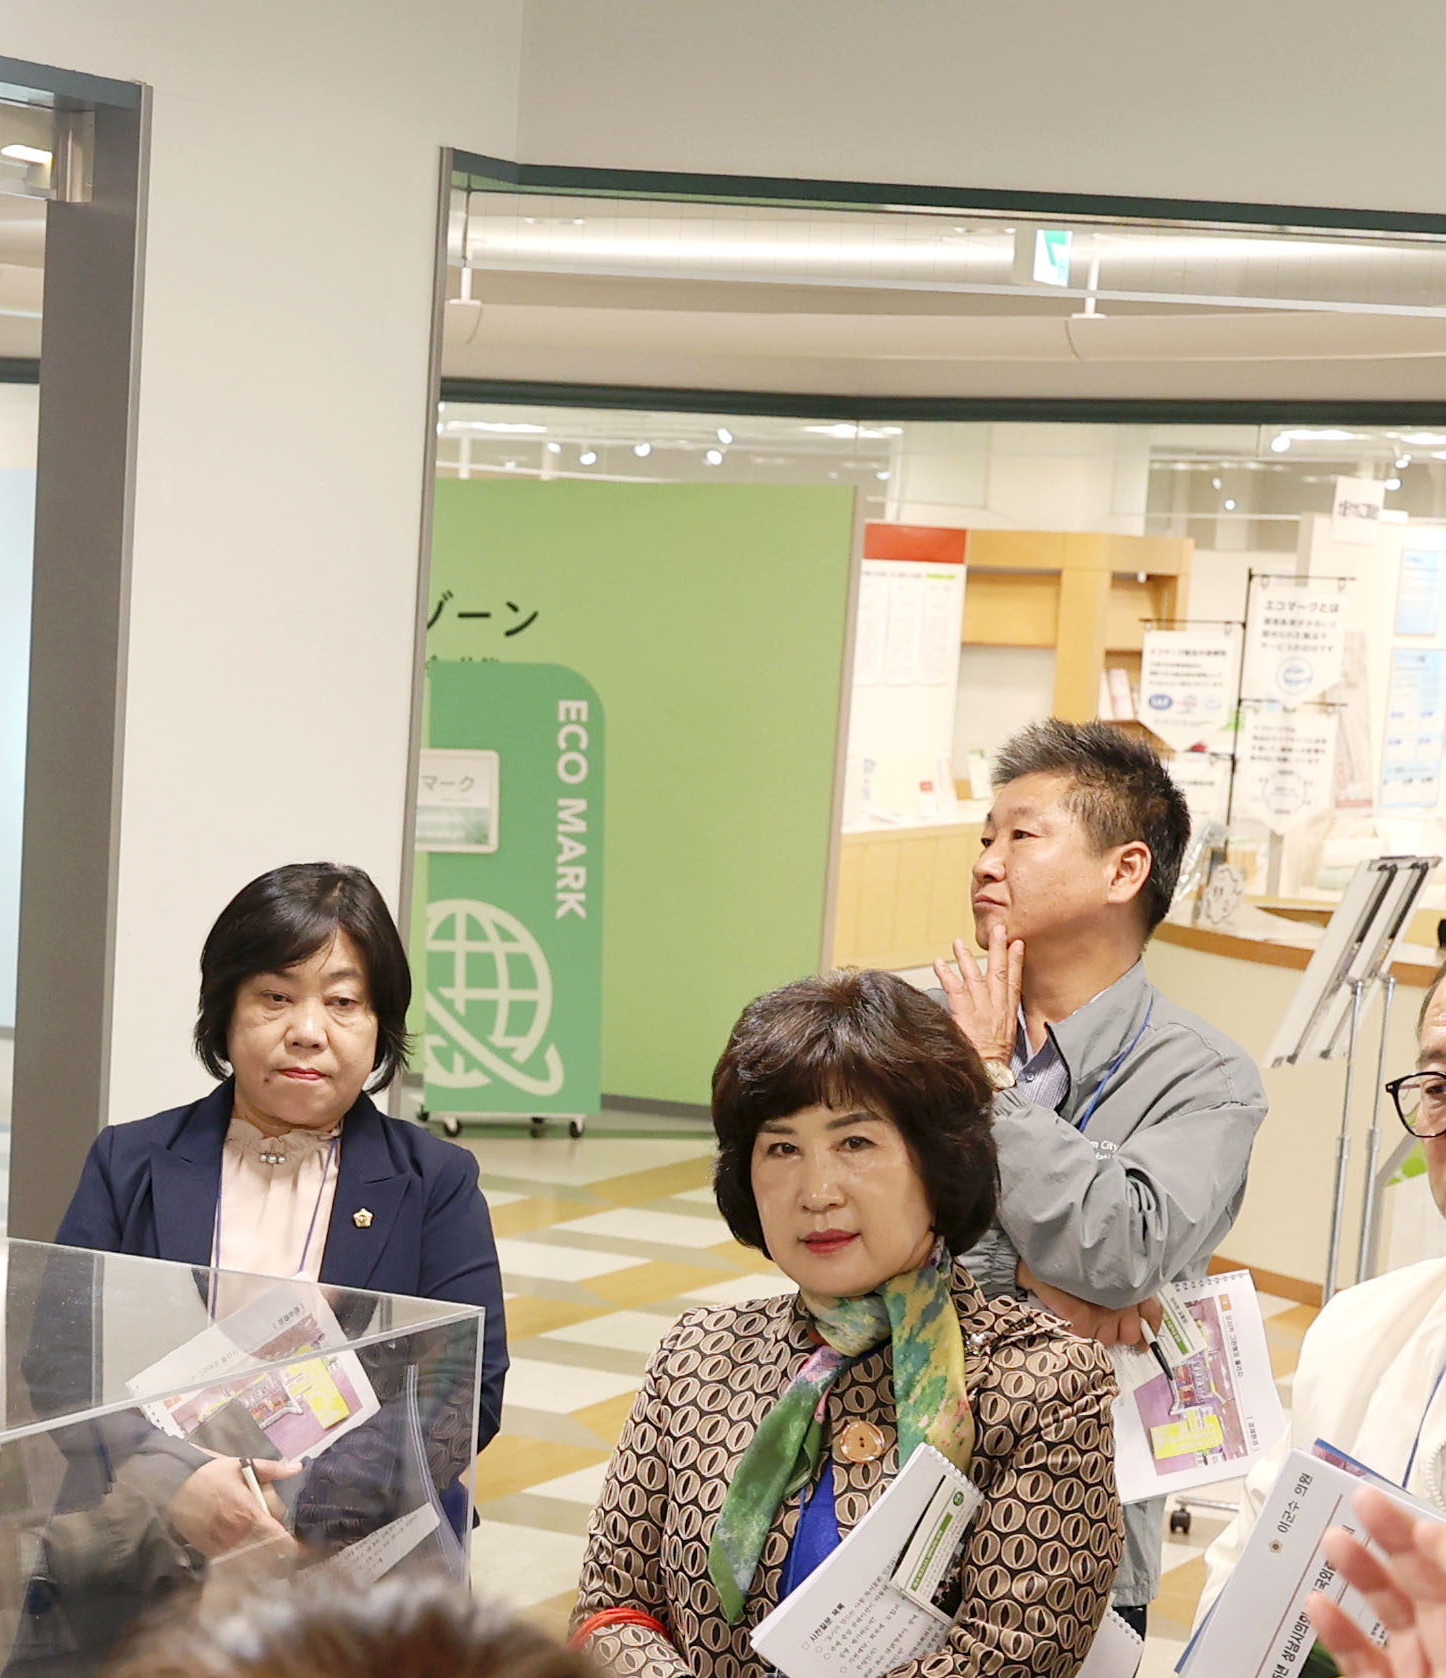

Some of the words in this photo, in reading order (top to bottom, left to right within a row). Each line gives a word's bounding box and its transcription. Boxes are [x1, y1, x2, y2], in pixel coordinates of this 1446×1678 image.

[556, 699, 589, 785] ECO
[555, 799, 589, 920] MARK
[1274, 1498, 1303, 1535] 이군수
[1291, 1470, 1315, 1497] 의원
[809, 1616, 833, 1643] 사전질문
[830, 1601, 845, 1617] 목록
